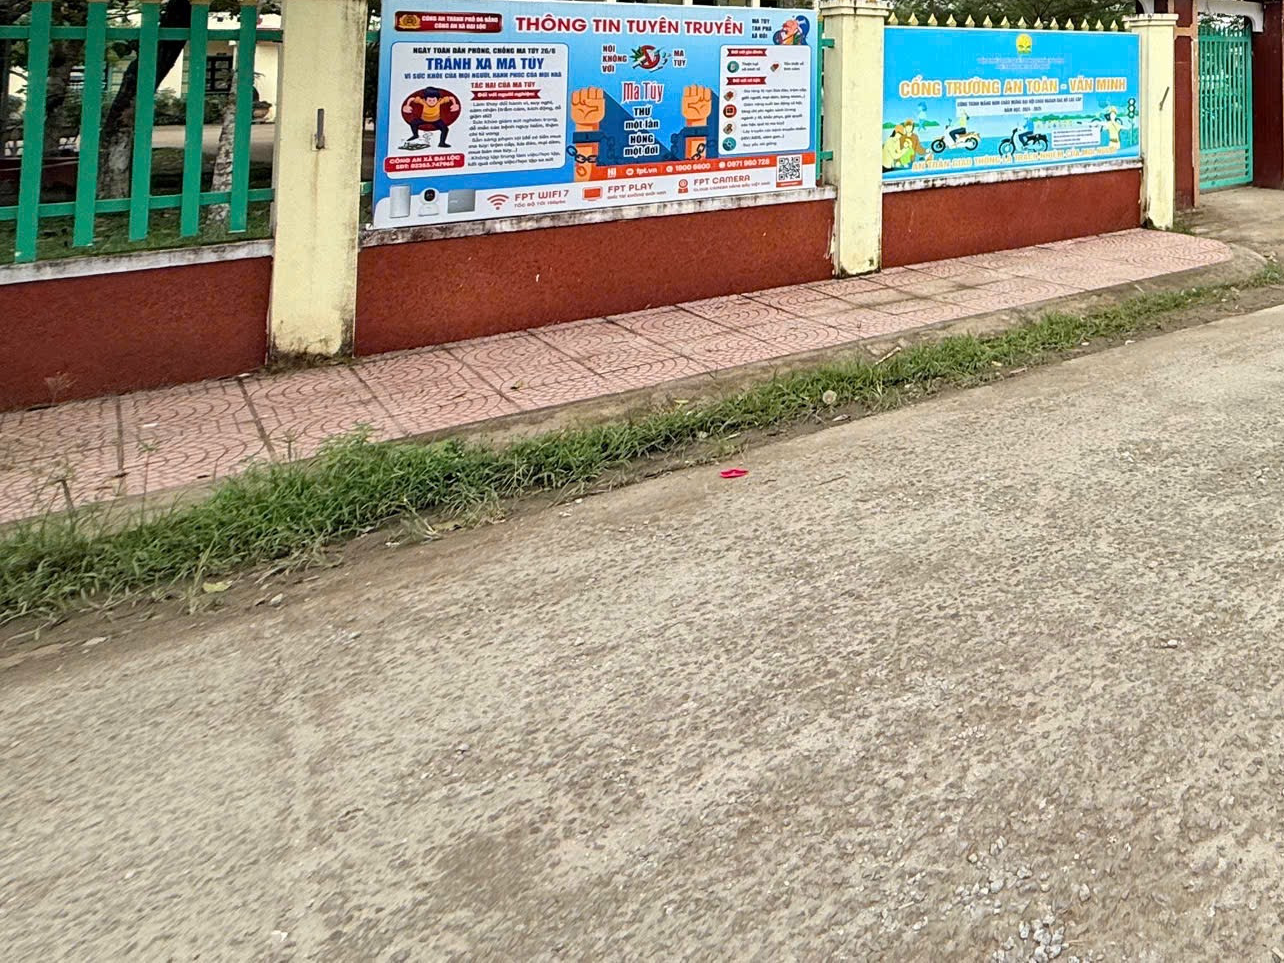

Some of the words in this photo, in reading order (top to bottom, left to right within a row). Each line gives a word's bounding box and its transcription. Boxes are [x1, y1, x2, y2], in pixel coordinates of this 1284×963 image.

[515, 14, 587, 32] THÔNG
[593, 19, 620, 33] TIN
[626, 17, 679, 34] TUYÊN
[685, 16, 743, 35] TRUYỀN
[425, 56, 471, 70] TRÁNH
[475, 58, 492, 70] XA
[496, 58, 516, 70] MA
[520, 56, 544, 70] TÚY
[623, 82, 639, 102] Ma
[946, 77, 1000, 95] TRƯỜNG
[1003, 80, 1024, 94] AN
[1026, 77, 1058, 93] TOÀN
[1068, 77, 1093, 93] VĂN
[1095, 78, 1126, 92] MINH
[625, 121, 642, 130] một
[625, 146, 642, 156] một
[693, 178, 710, 186] FPT
[712, 175, 750, 184] CAMERA
[607, 184, 626, 193] FPT
[628, 182, 654, 191] PLAY
[514, 192, 535, 201] FPT
[538, 190, 561, 199] WIFI
[563, 189, 569, 197] 7
